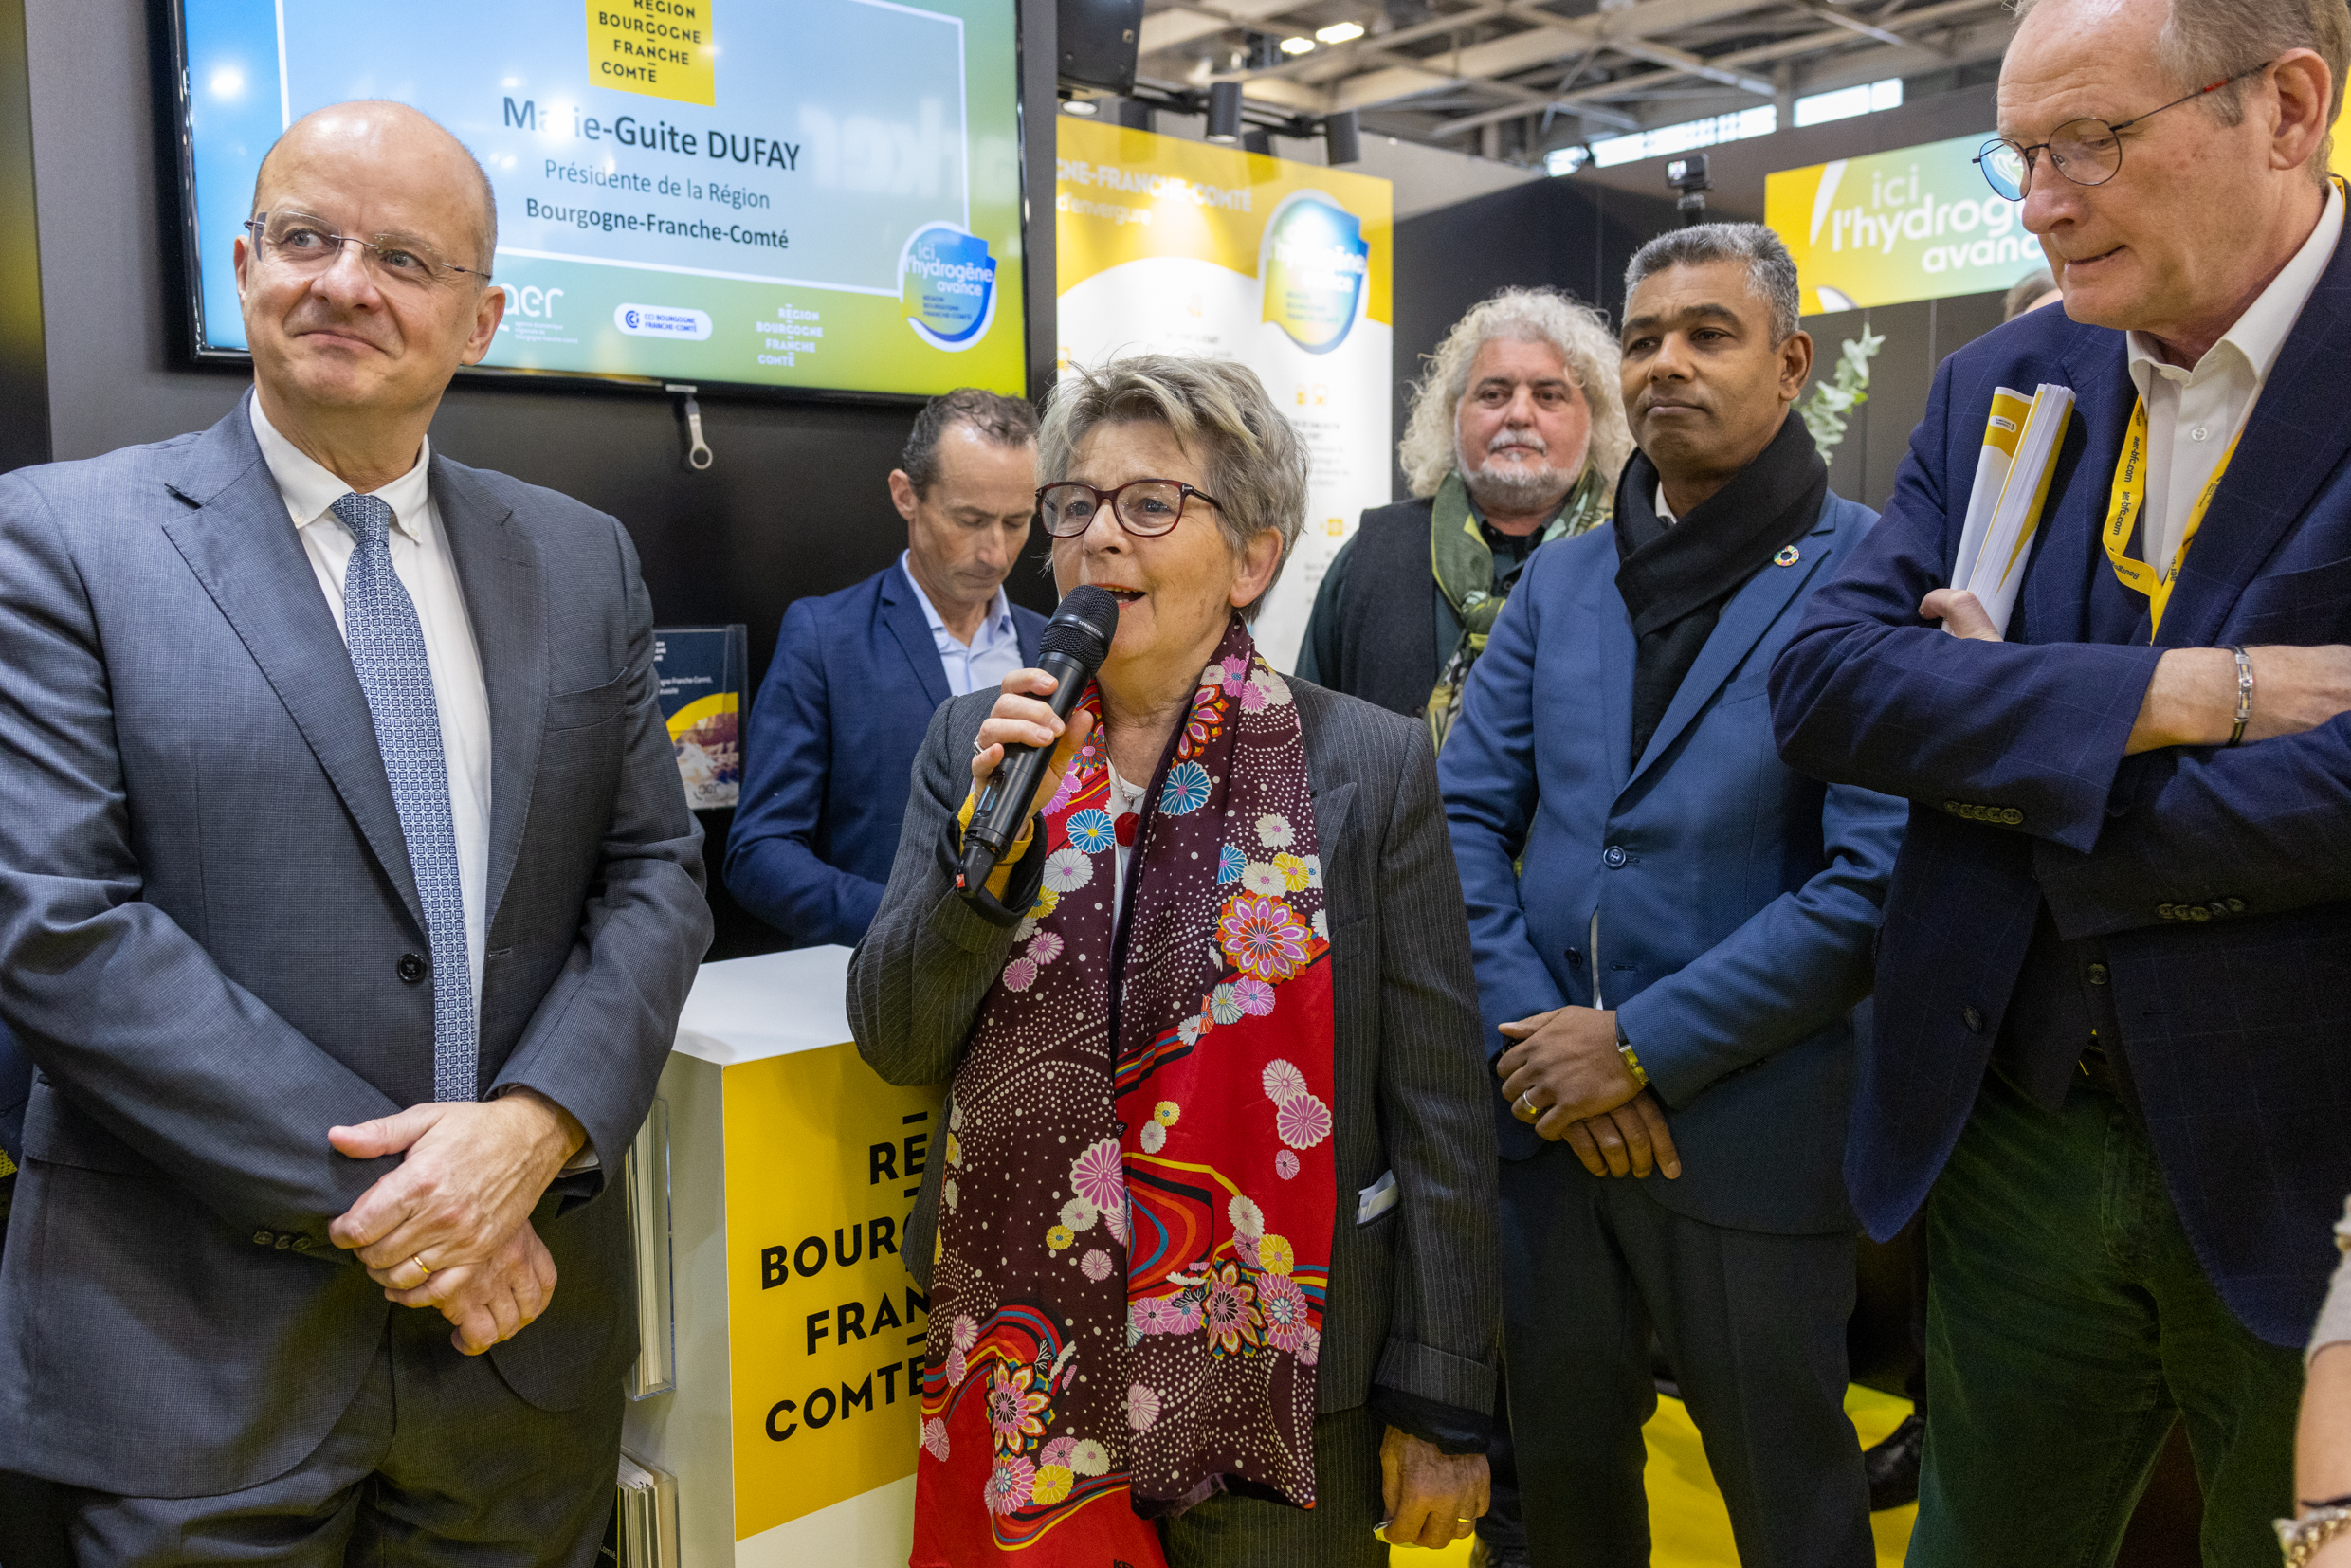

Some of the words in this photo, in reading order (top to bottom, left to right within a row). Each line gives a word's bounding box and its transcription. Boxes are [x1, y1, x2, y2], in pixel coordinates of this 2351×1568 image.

[599, 11, 702, 44] BOURGOGNE
[613, 38, 690, 65] FRANCHE
[502, 96, 698, 155] Mie-Guite
[707, 130, 801, 171] DUFAY
[545, 158, 652, 193] Présidente
[657, 175, 682, 195] de
[686, 178, 703, 200] la
[709, 182, 771, 210] Région
[1871, 163, 1920, 210] ici
[525, 197, 790, 249] Bourgogne-Franche-Comté
[1832, 192, 2024, 255] l'hydrog
[936, 280, 984, 297] avance
[756, 320, 824, 337] BOURGOGNE
[765, 337, 816, 354] FRANCHE
[2123, 435, 2141, 483] aer-bfc.com
[2112, 490, 2132, 537] aer-bfc.com
